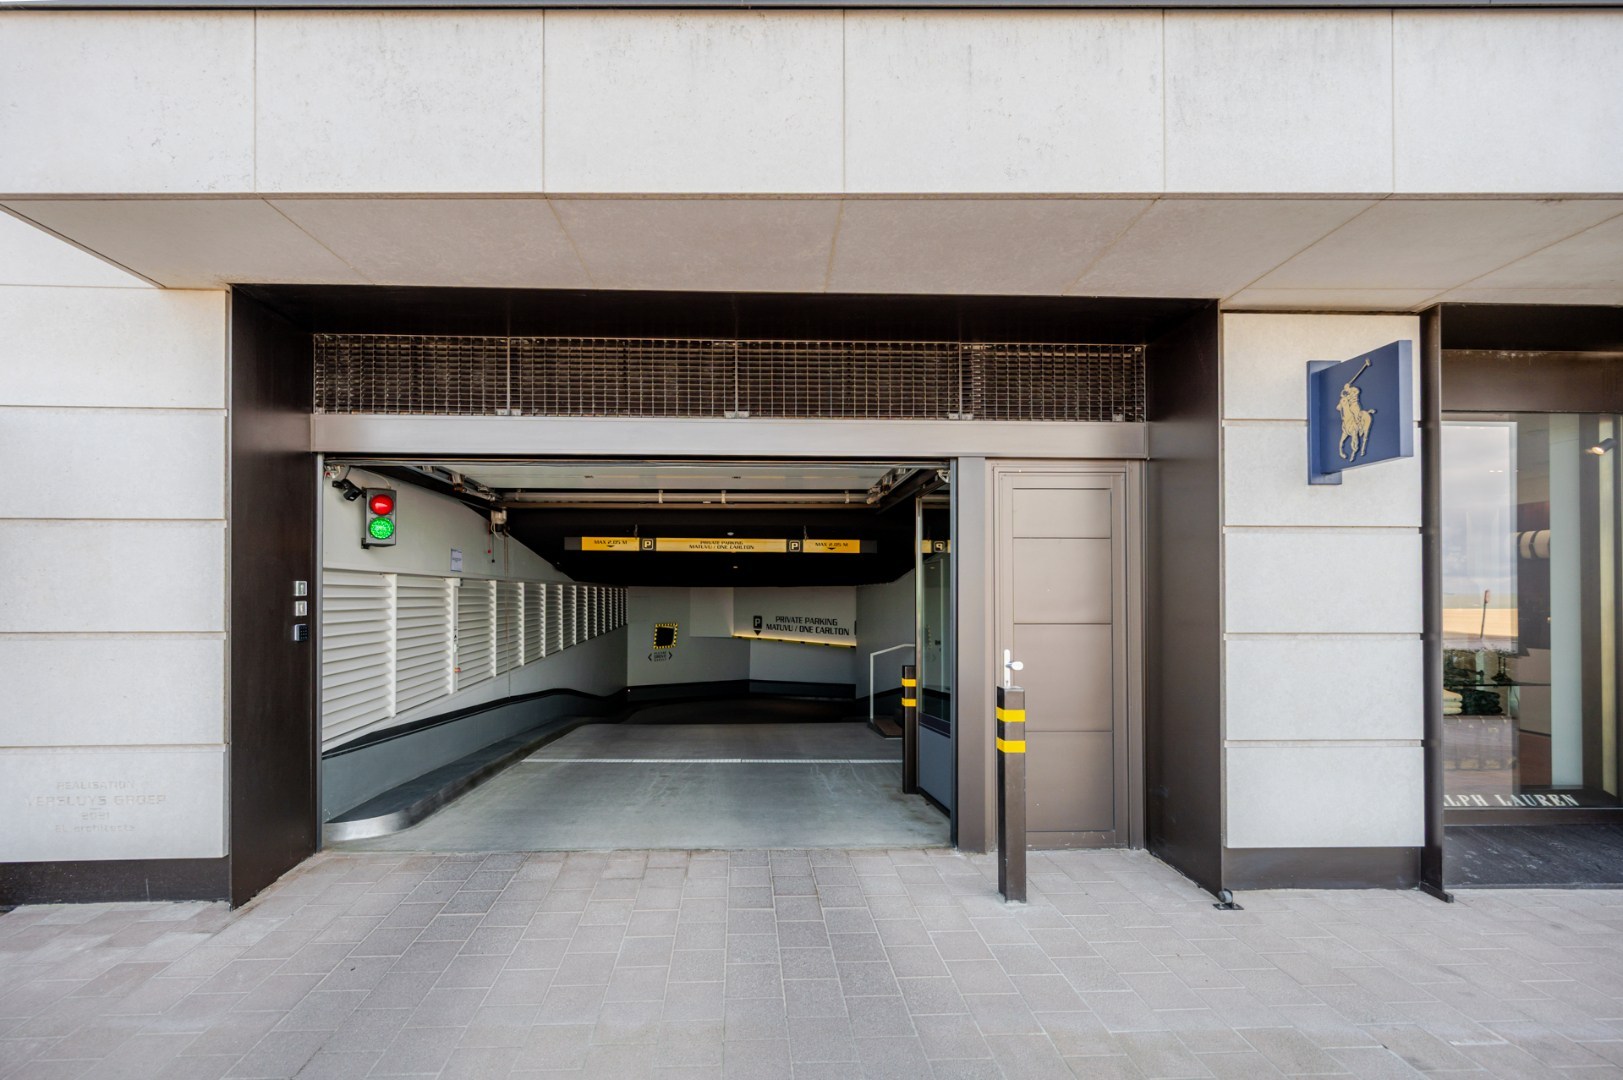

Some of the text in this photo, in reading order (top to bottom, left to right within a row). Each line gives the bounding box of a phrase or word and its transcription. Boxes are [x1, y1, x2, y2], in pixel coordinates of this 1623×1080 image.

[775, 616, 838, 626] PRIVATE PARKING
[799, 625, 814, 633] ONE
[815, 627, 850, 636] CARLTON
[1494, 794, 1579, 807] LAUREN
